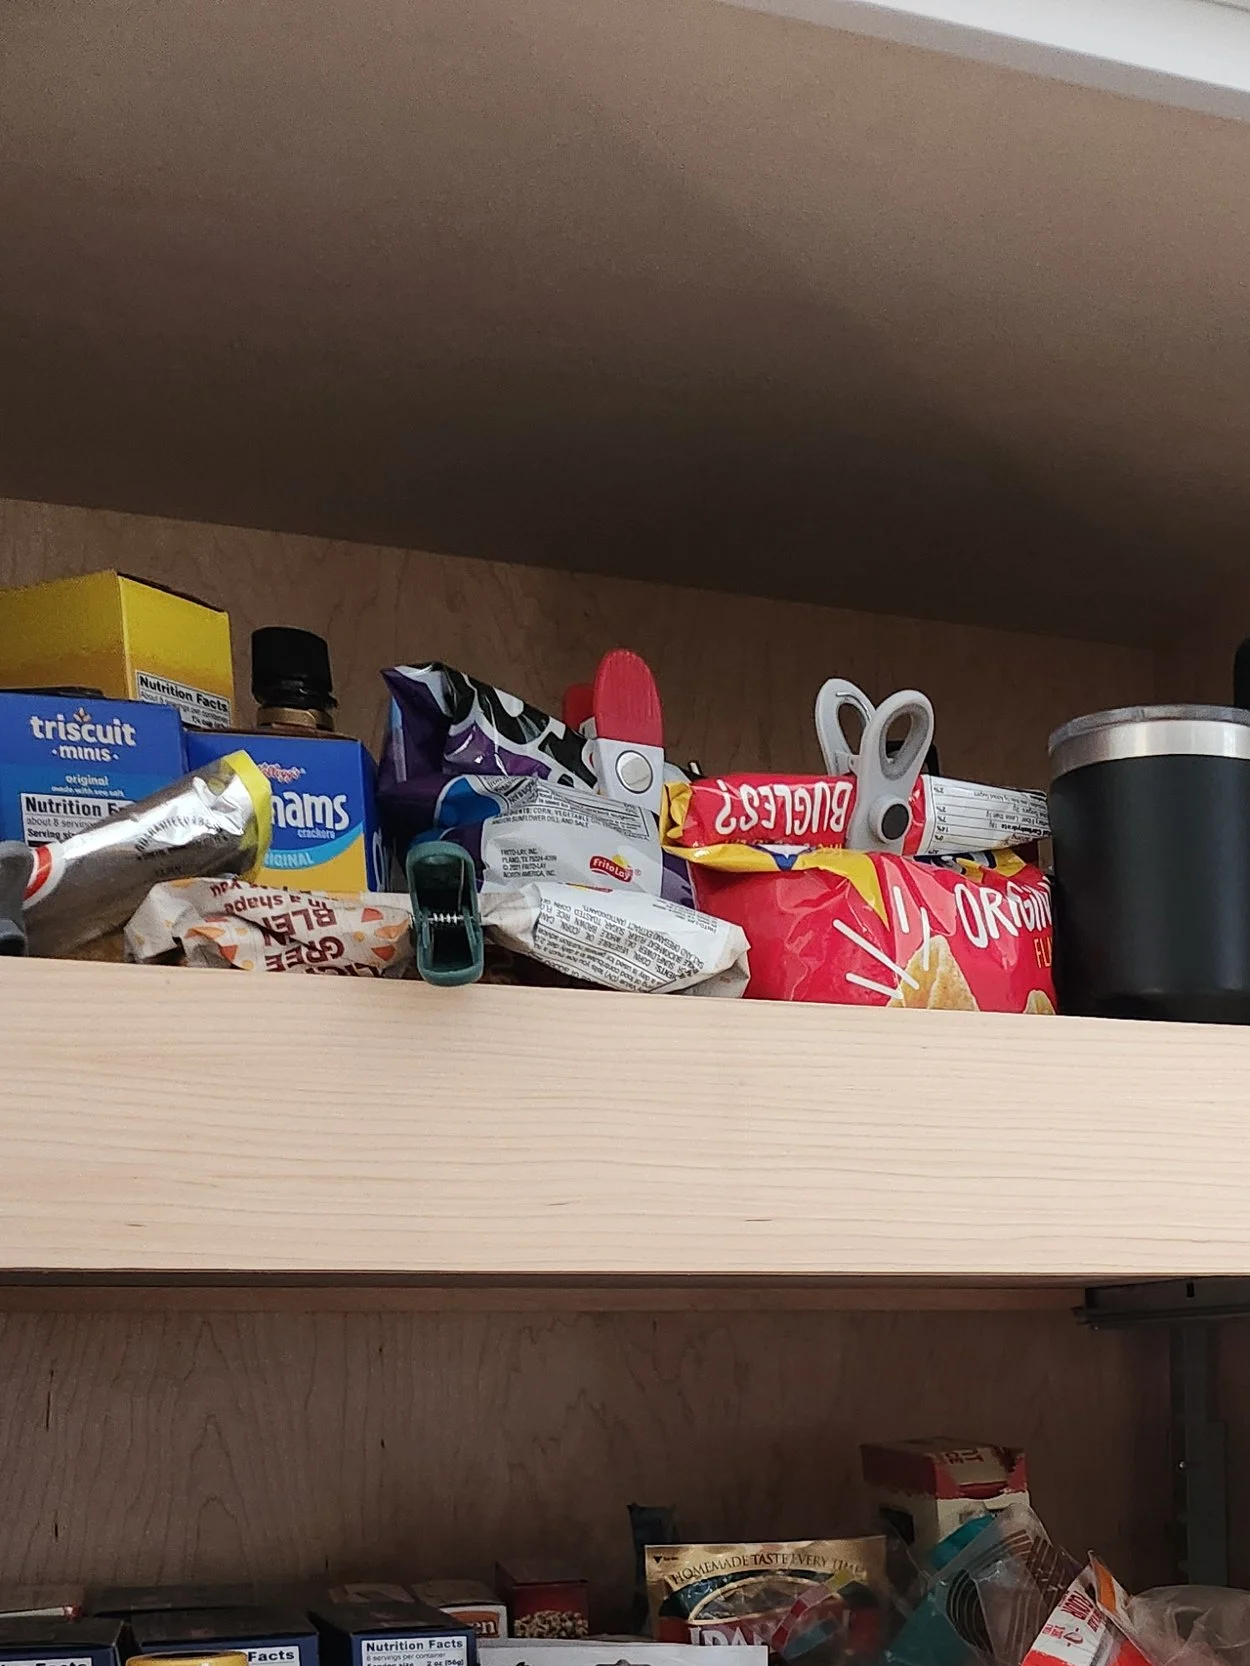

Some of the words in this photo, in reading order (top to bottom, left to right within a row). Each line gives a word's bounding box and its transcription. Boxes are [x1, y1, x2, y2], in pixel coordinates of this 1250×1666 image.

[139, 675, 193, 702] Nutrition
[196, 691, 229, 713] Facts
[30, 714, 136, 747] triscuit
[65, 774, 109, 786] original
[25, 797, 102, 816] Nutrition
[27, 828, 61, 840] Serving
[223, 892, 284, 914] shape
[672, 1554, 749, 1586] HOMEMADE
[751, 1553, 788, 1567] TASTE
[366, 1641, 424, 1652] Nutrition
[429, 1639, 464, 1650] Facts
[248, 1650, 295, 1663] Facts
